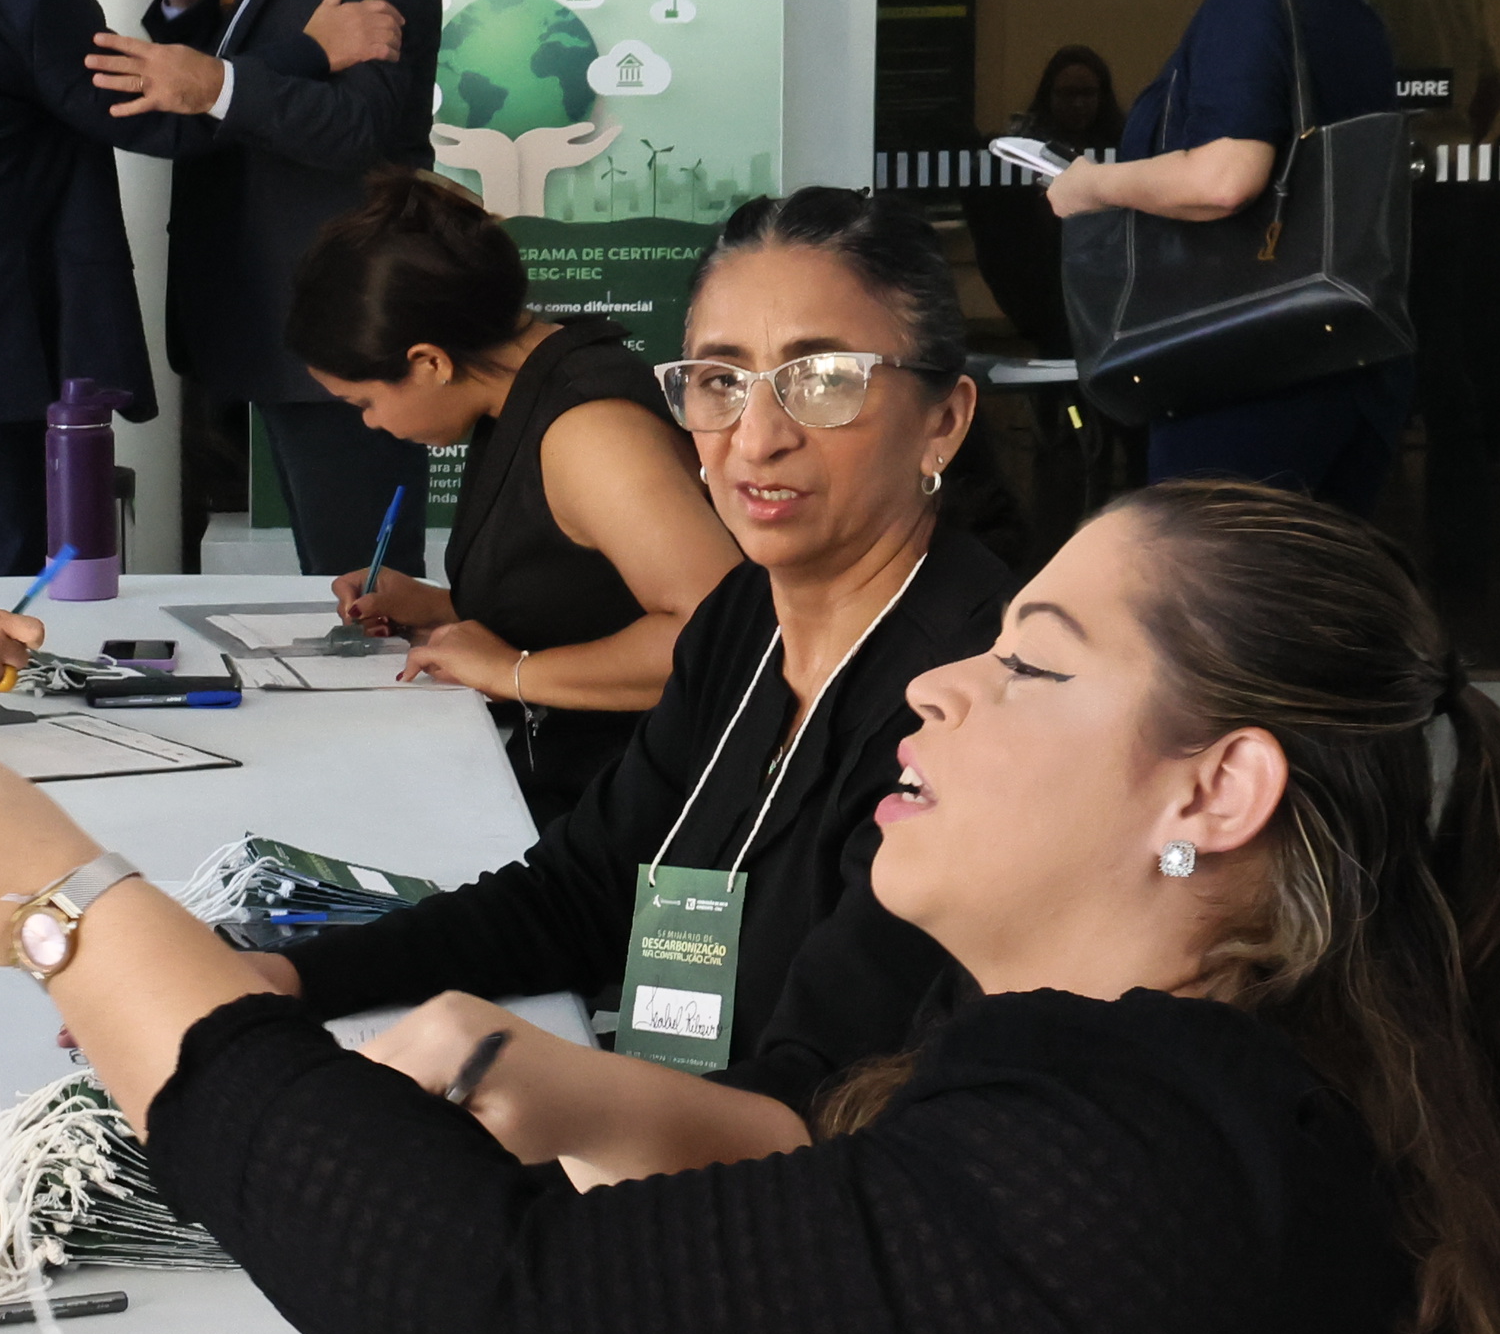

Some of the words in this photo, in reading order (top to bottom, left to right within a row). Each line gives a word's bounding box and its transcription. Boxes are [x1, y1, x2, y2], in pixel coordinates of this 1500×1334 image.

[581, 247, 605, 261] DE
[544, 302, 582, 312] como
[583, 300, 653, 313] diferencial
[657, 929, 702, 943] SEMINÁRIO
[641, 936, 727, 957] DESCARBONIZAÇÃO
[642, 949, 654, 958] NA
